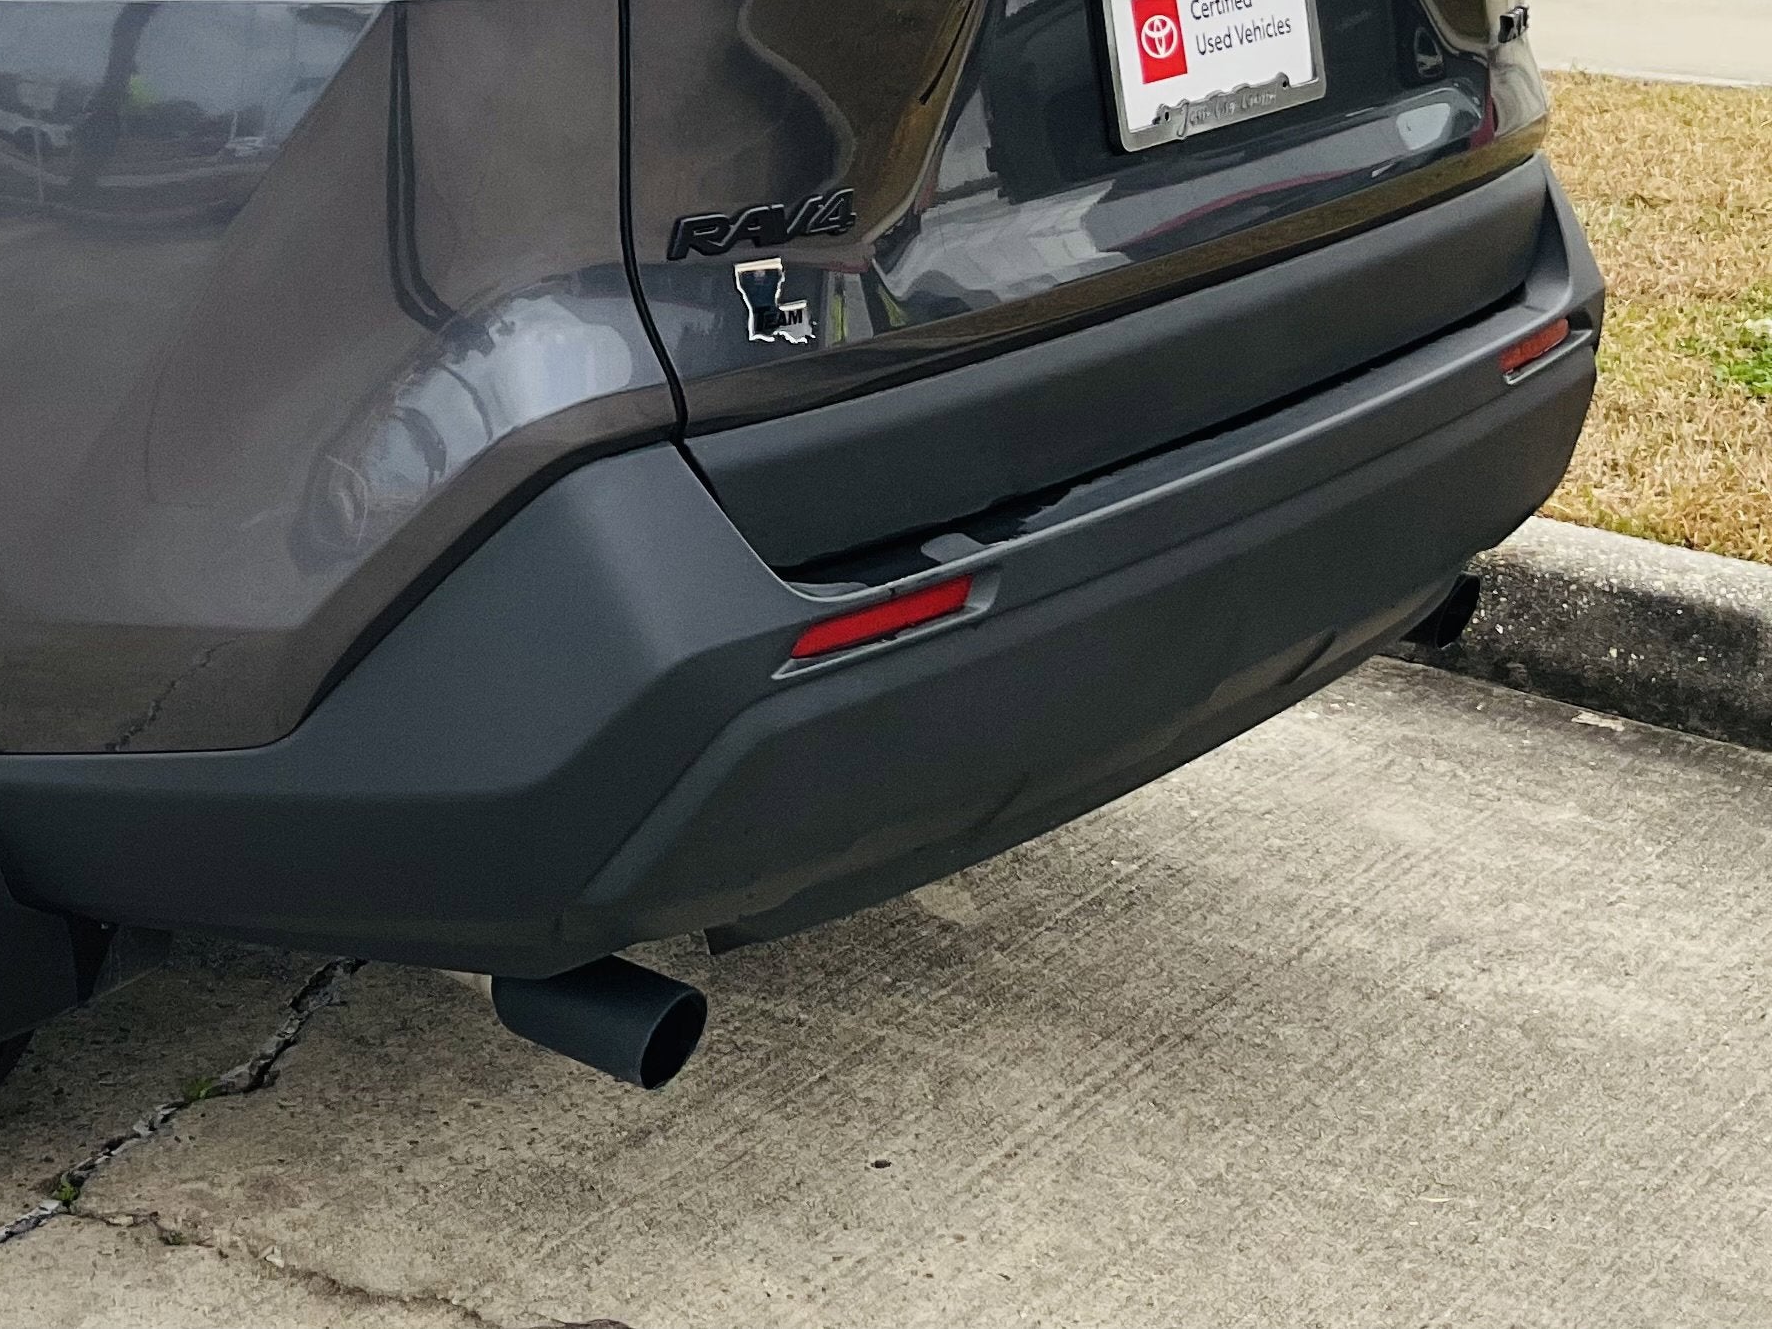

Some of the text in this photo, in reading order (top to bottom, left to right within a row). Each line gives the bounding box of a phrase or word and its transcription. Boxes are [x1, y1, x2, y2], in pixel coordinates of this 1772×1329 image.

[1196, 15, 1292, 55] Used Vehicles
[666, 187, 857, 261] RAV4
